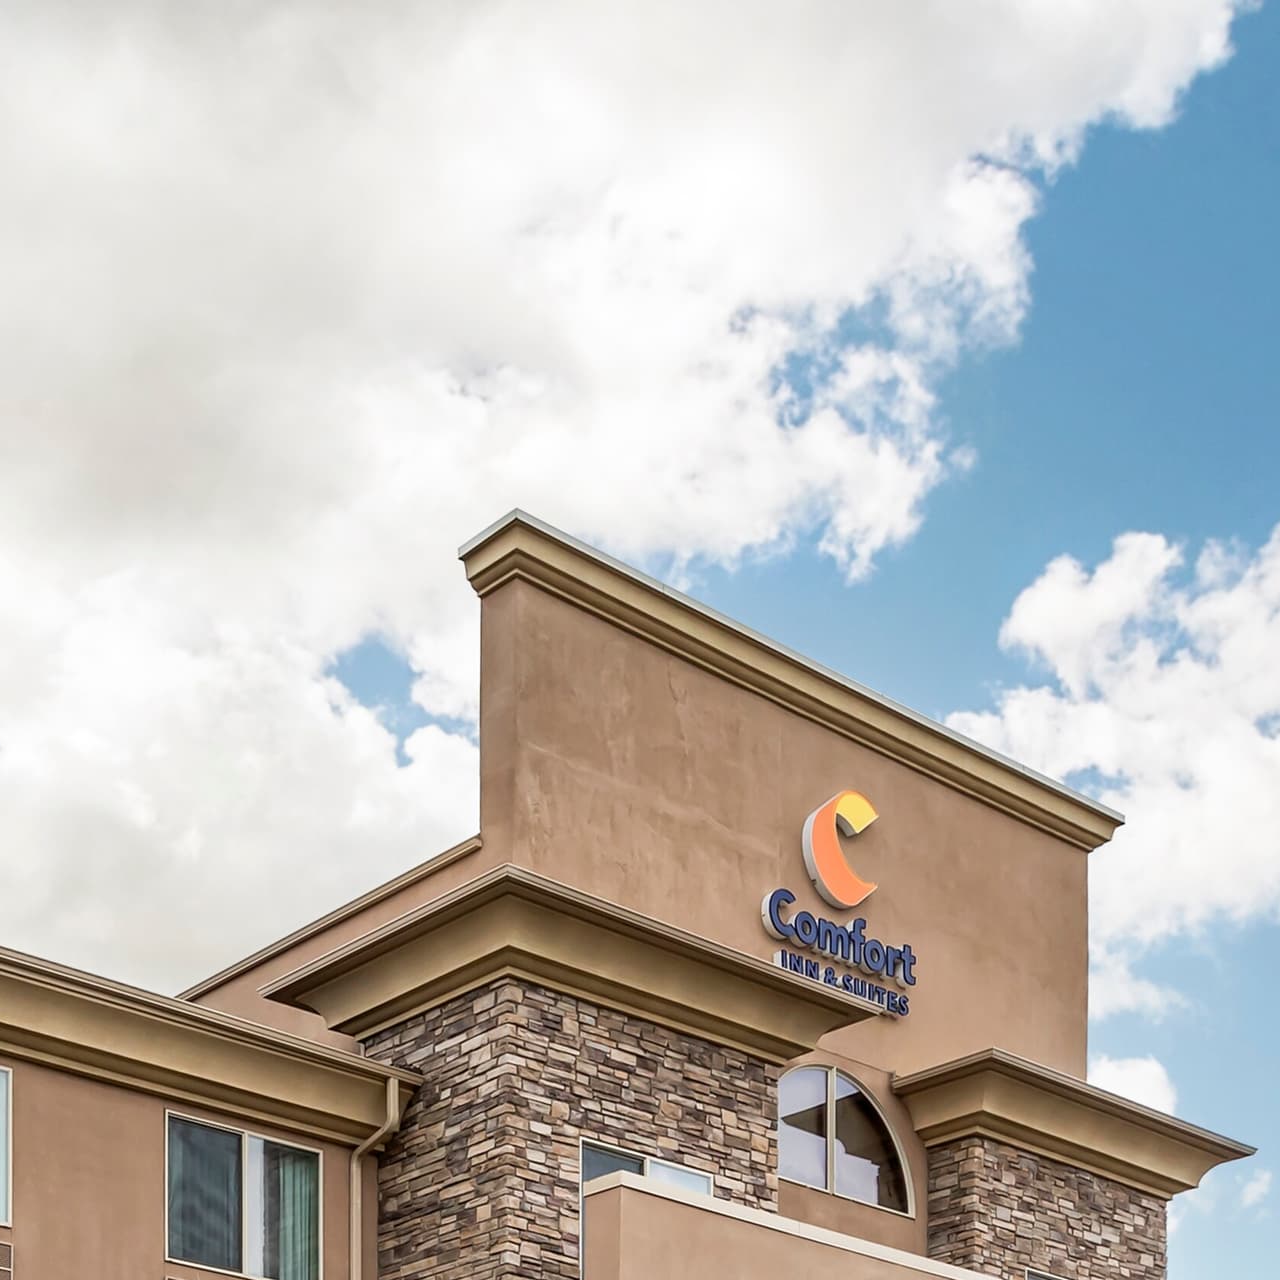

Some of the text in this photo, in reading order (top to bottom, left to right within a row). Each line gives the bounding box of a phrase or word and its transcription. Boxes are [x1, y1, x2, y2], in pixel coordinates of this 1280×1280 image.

[762, 888, 916, 987] Comfort
[776, 949, 910, 1017] INN & SUITES
